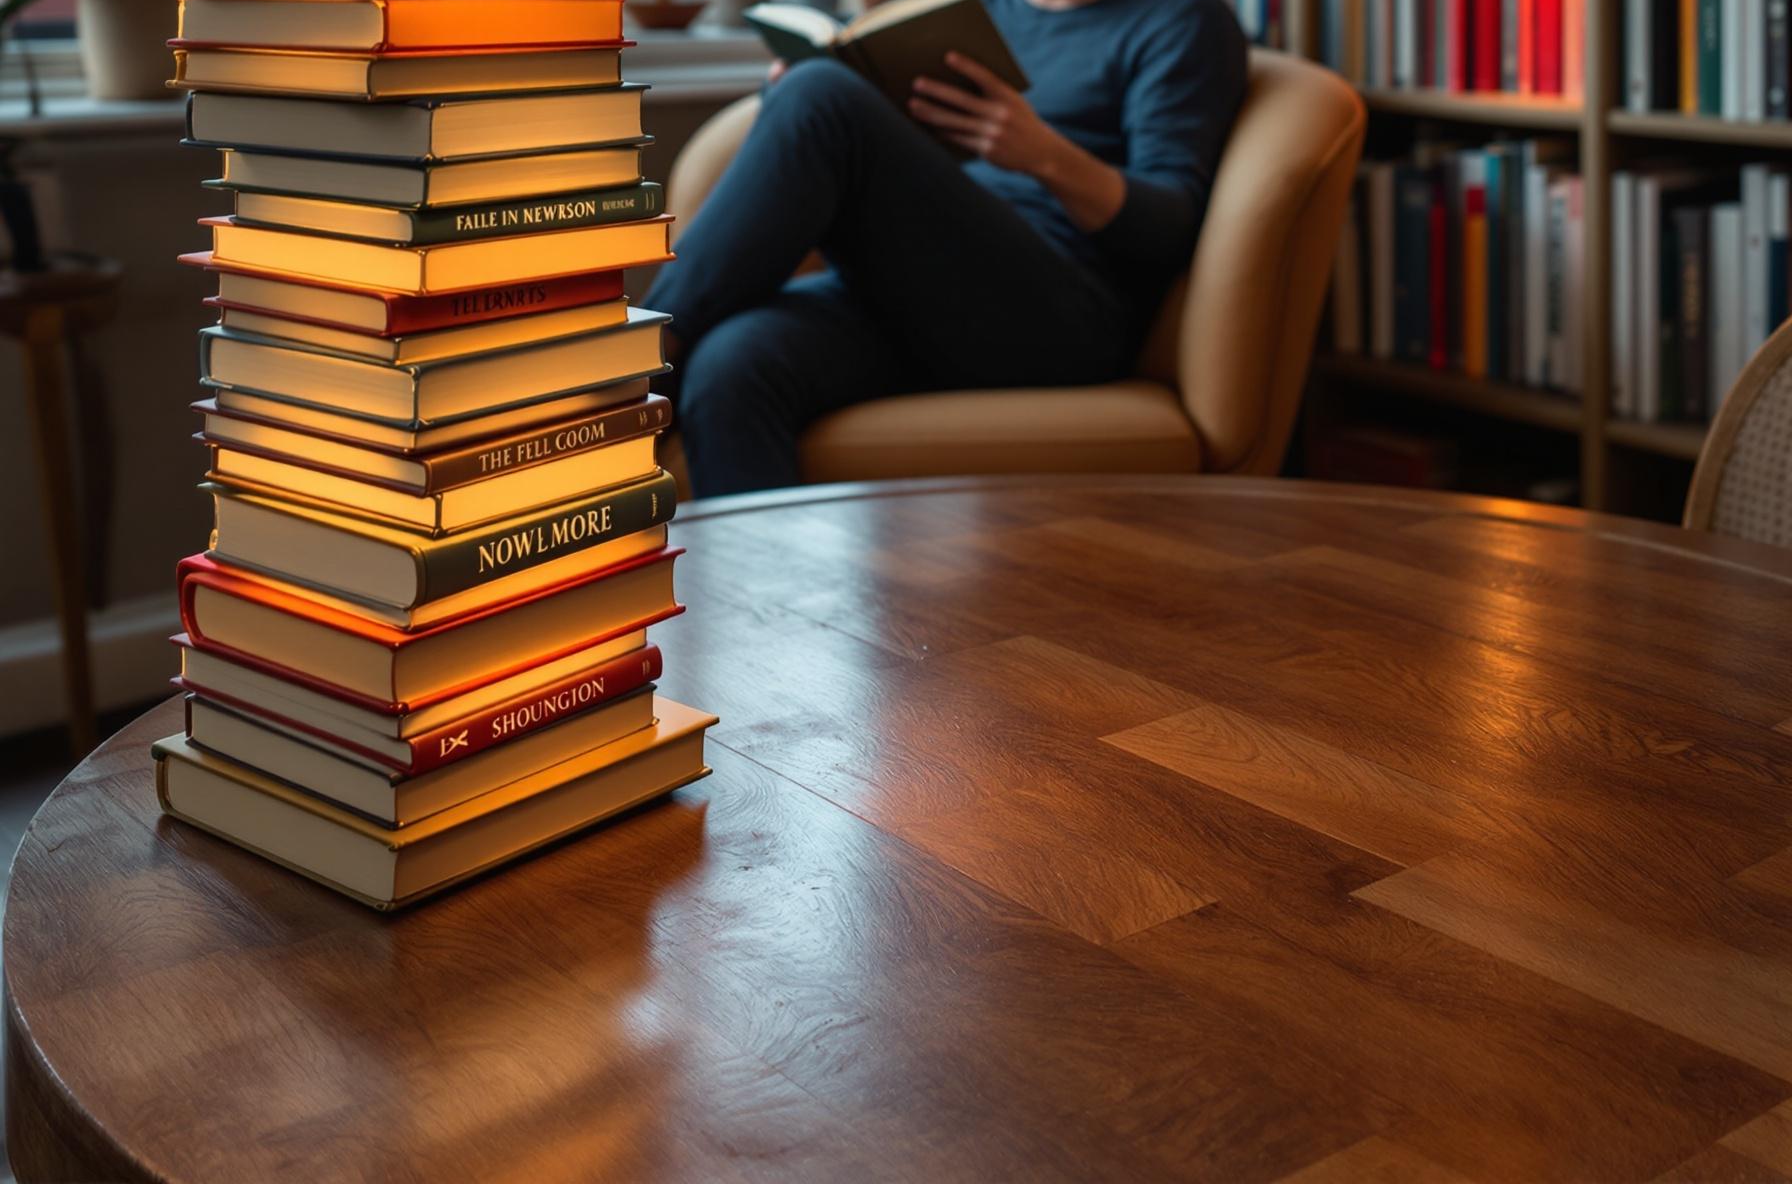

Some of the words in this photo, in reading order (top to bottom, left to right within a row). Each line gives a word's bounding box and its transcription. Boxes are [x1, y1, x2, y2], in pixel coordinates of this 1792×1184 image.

[456, 212, 497, 231] FALLE
[502, 209, 518, 226] IN
[523, 200, 596, 224] NEWRSON
[478, 447, 512, 472] THE
[517, 438, 551, 462] FELL
